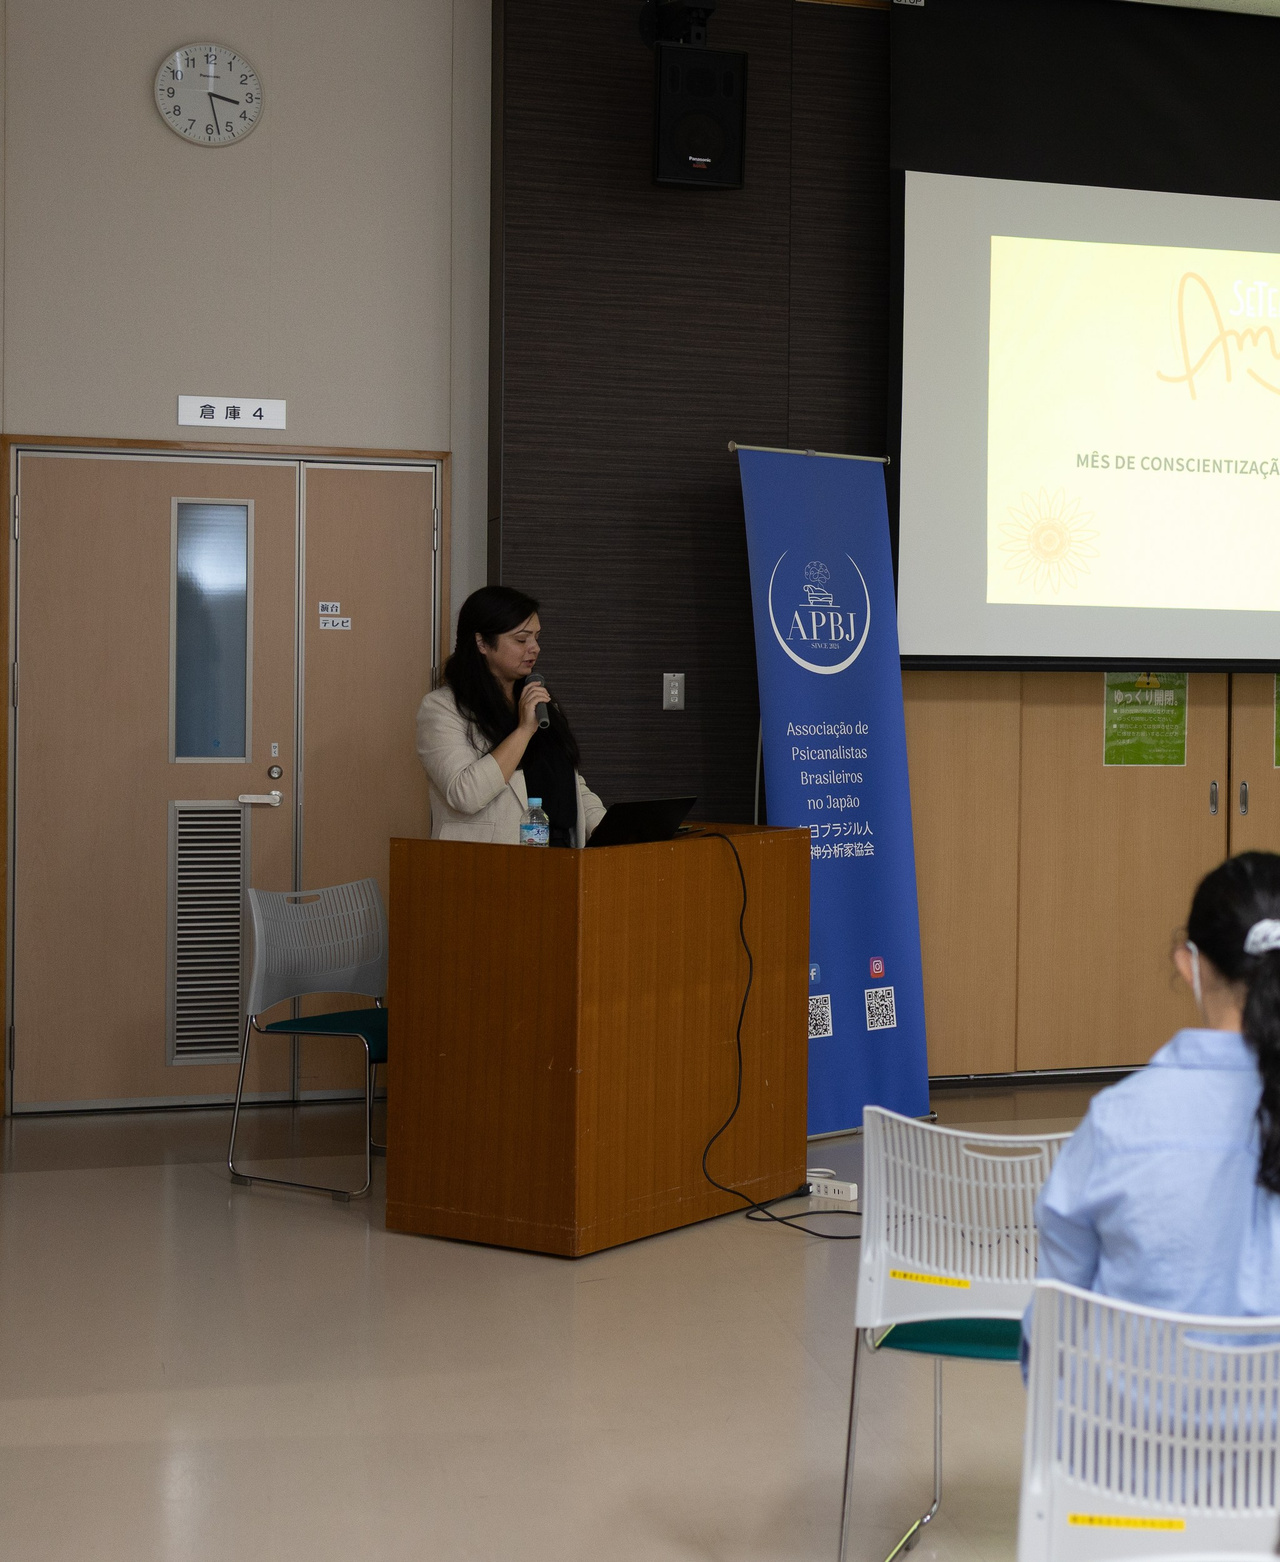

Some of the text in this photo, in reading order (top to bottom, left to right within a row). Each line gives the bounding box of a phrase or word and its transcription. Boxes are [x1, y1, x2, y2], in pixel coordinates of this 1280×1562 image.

[185, 57, 196, 68] 11
[204, 54, 217, 65] 12
[227, 61, 233, 72] 1
[170, 69, 183, 80] 10
[239, 74, 248, 85] 2
[166, 87, 175, 98] 9
[245, 92, 254, 104] 3
[172, 105, 181, 116] 8
[239, 110, 248, 121] 4
[188, 119, 196, 130] 7
[205, 124, 214, 135] 6
[225, 121, 234, 132] 5
[1077, 450, 1110, 469] MÊS
[1115, 455, 1136, 470] DE
[321, 619, 349, 628] テレビ
[786, 610, 857, 642] APBJ
[810, 642, 828, 650] SINCE
[786, 721, 869, 738] Associação de
[791, 745, 868, 761] Psicanalistas
[800, 770, 863, 785] Brasileiros
[807, 795, 860, 812] no Japão
[799, 821, 873, 838] 日ブラジル人
